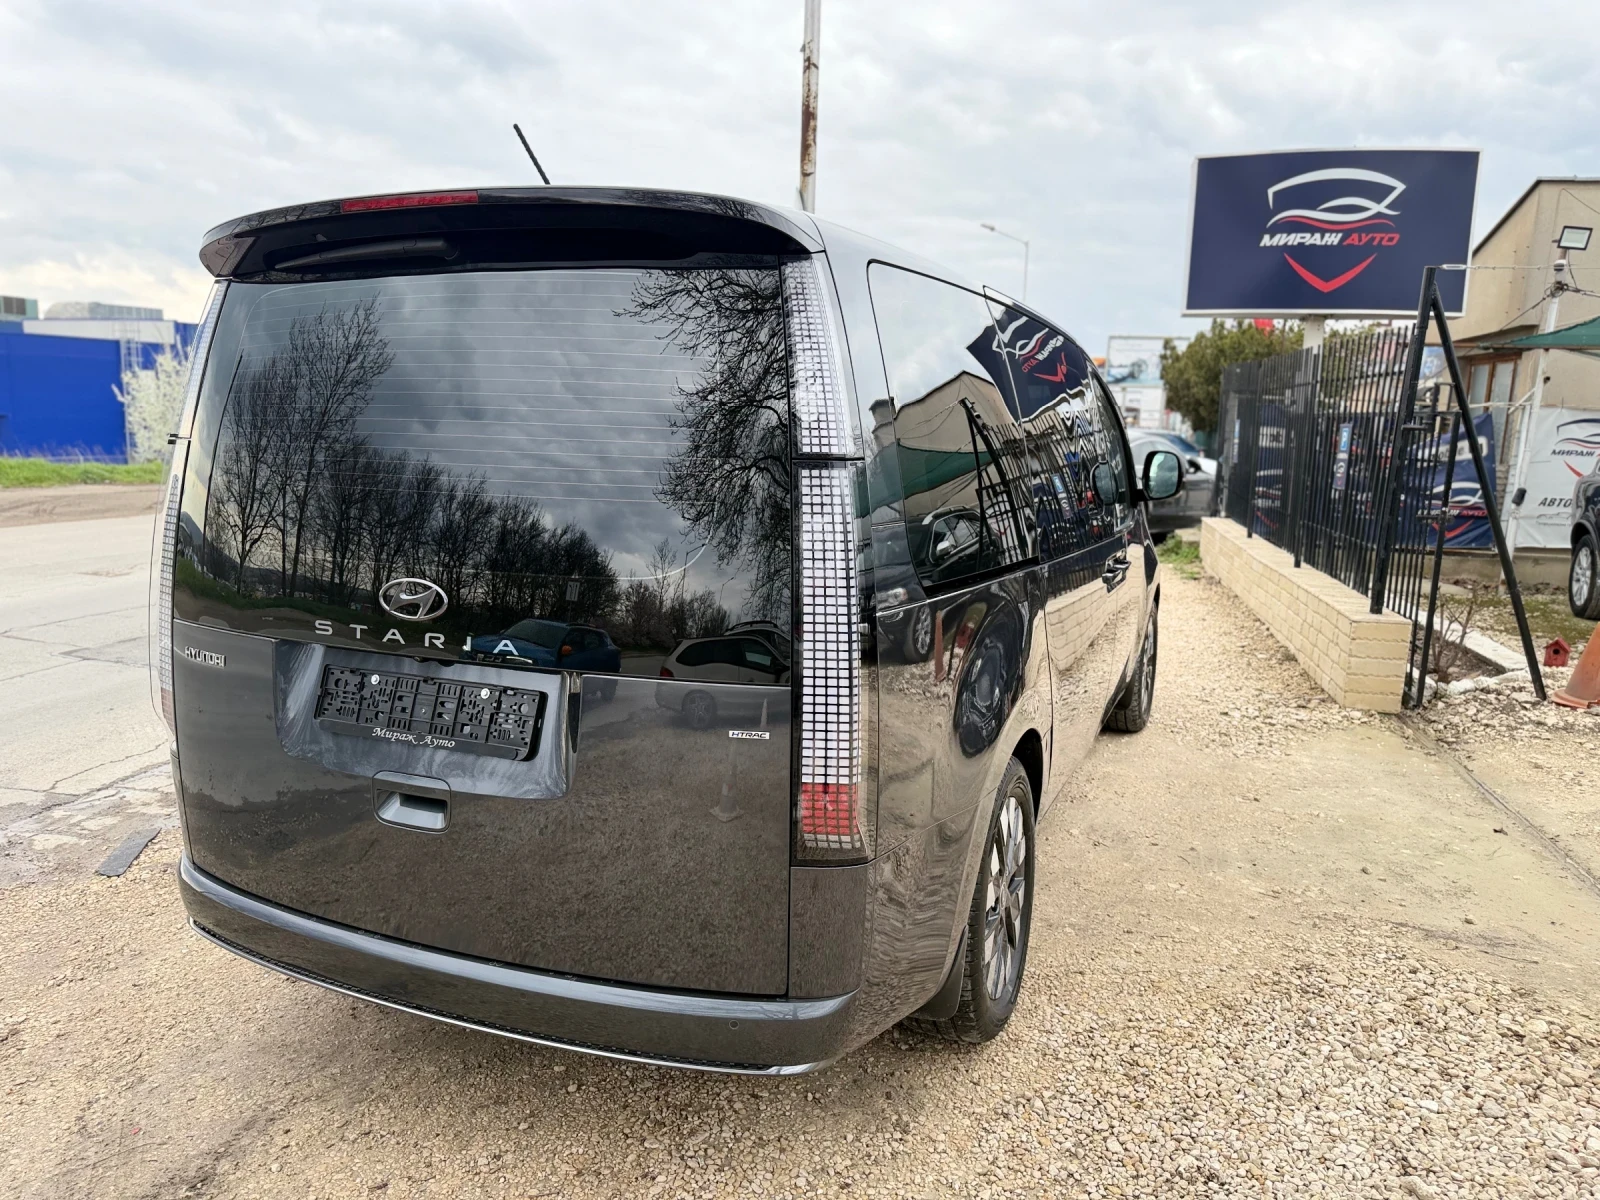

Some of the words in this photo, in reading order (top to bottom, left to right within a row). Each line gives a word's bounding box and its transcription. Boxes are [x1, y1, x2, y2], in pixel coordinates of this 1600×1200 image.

[1259, 233, 1343, 247] МИРАЖ
[1342, 233, 1400, 246] АУТО
[1550, 449, 1596, 457] МИРАЖ
[314, 620, 520, 656] STARIA
[372, 727, 418, 745] Мираж
[419, 735, 456, 748] Ауто
[731, 731, 767, 739] HTRAC
